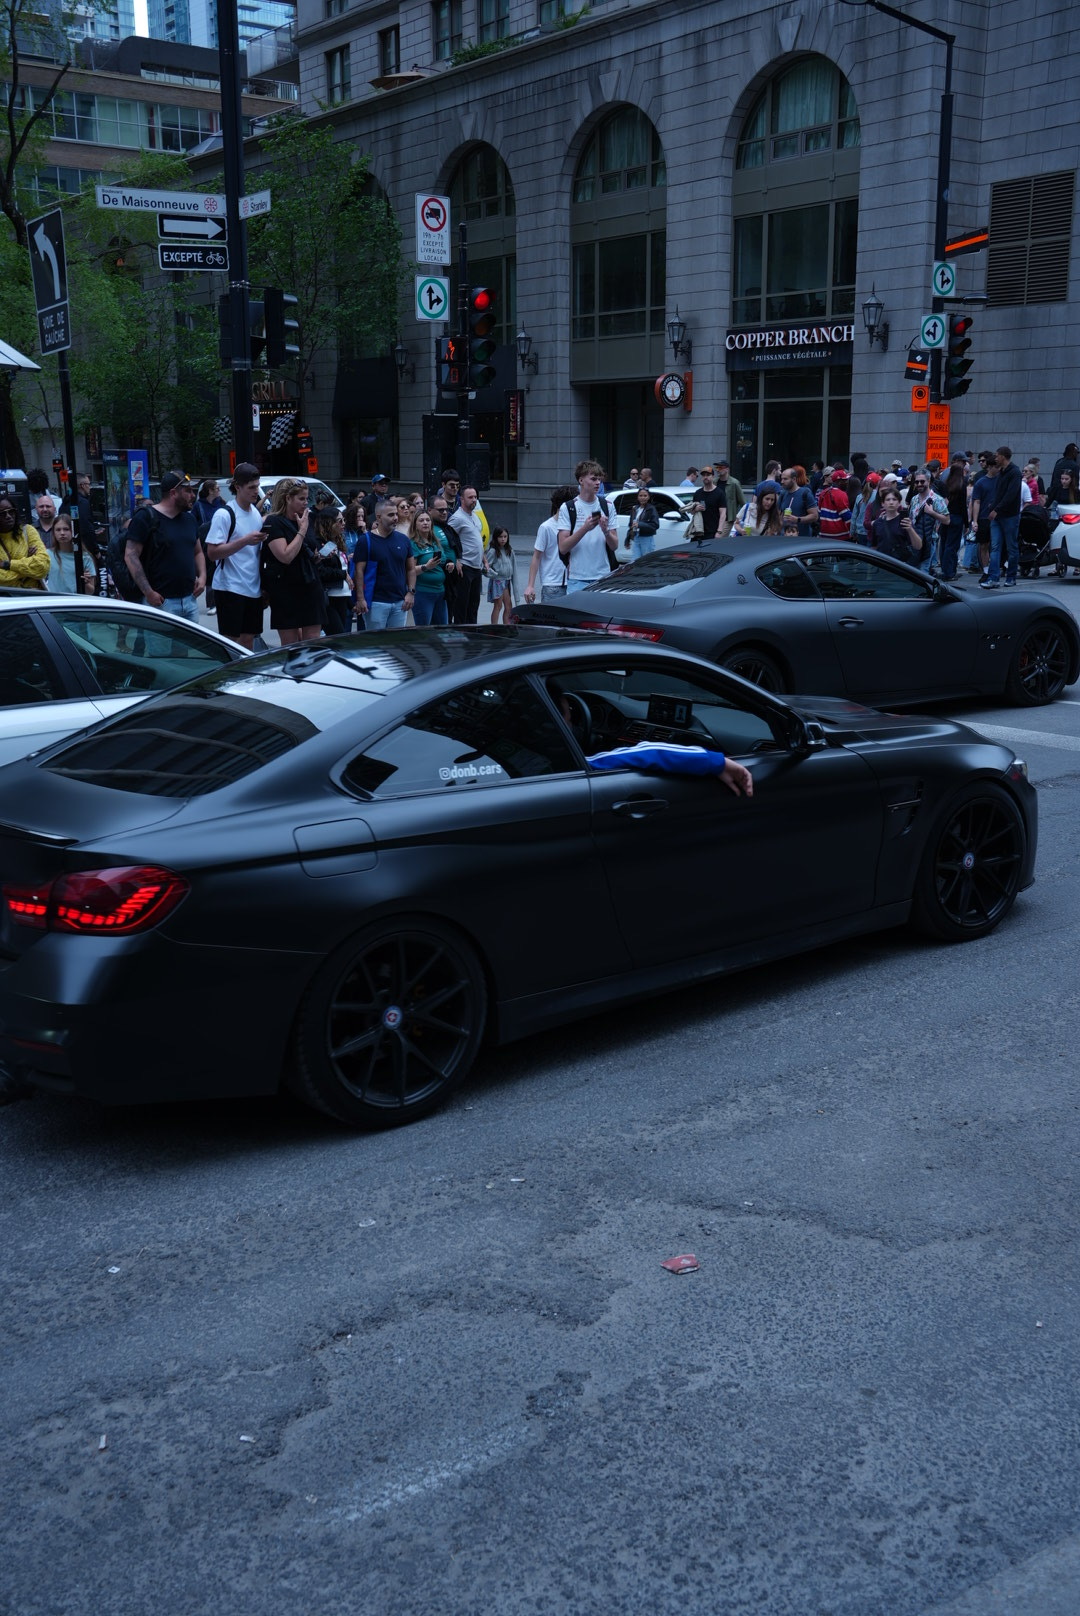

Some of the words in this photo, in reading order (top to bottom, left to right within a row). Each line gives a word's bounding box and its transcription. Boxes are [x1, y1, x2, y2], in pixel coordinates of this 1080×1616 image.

[102, 194, 119, 206] De
[122, 195, 199, 211] Maisonneuve
[250, 199, 268, 213] Stanley
[162, 250, 204, 263] EXCEPTÉ
[420, 247, 447, 255] LIVRAISON
[56, 311, 65, 325] DE
[45, 328, 65, 346] GAUCHE
[725, 330, 786, 351] COPPER
[788, 325, 855, 346] BRANCH
[755, 353, 791, 362] PUISSANCE
[792, 350, 828, 359] VÉGÉTALE
[251, 380, 291, 402] GRILL
[934, 411, 945, 420] RUE
[930, 423, 949, 432] BARRÉE
